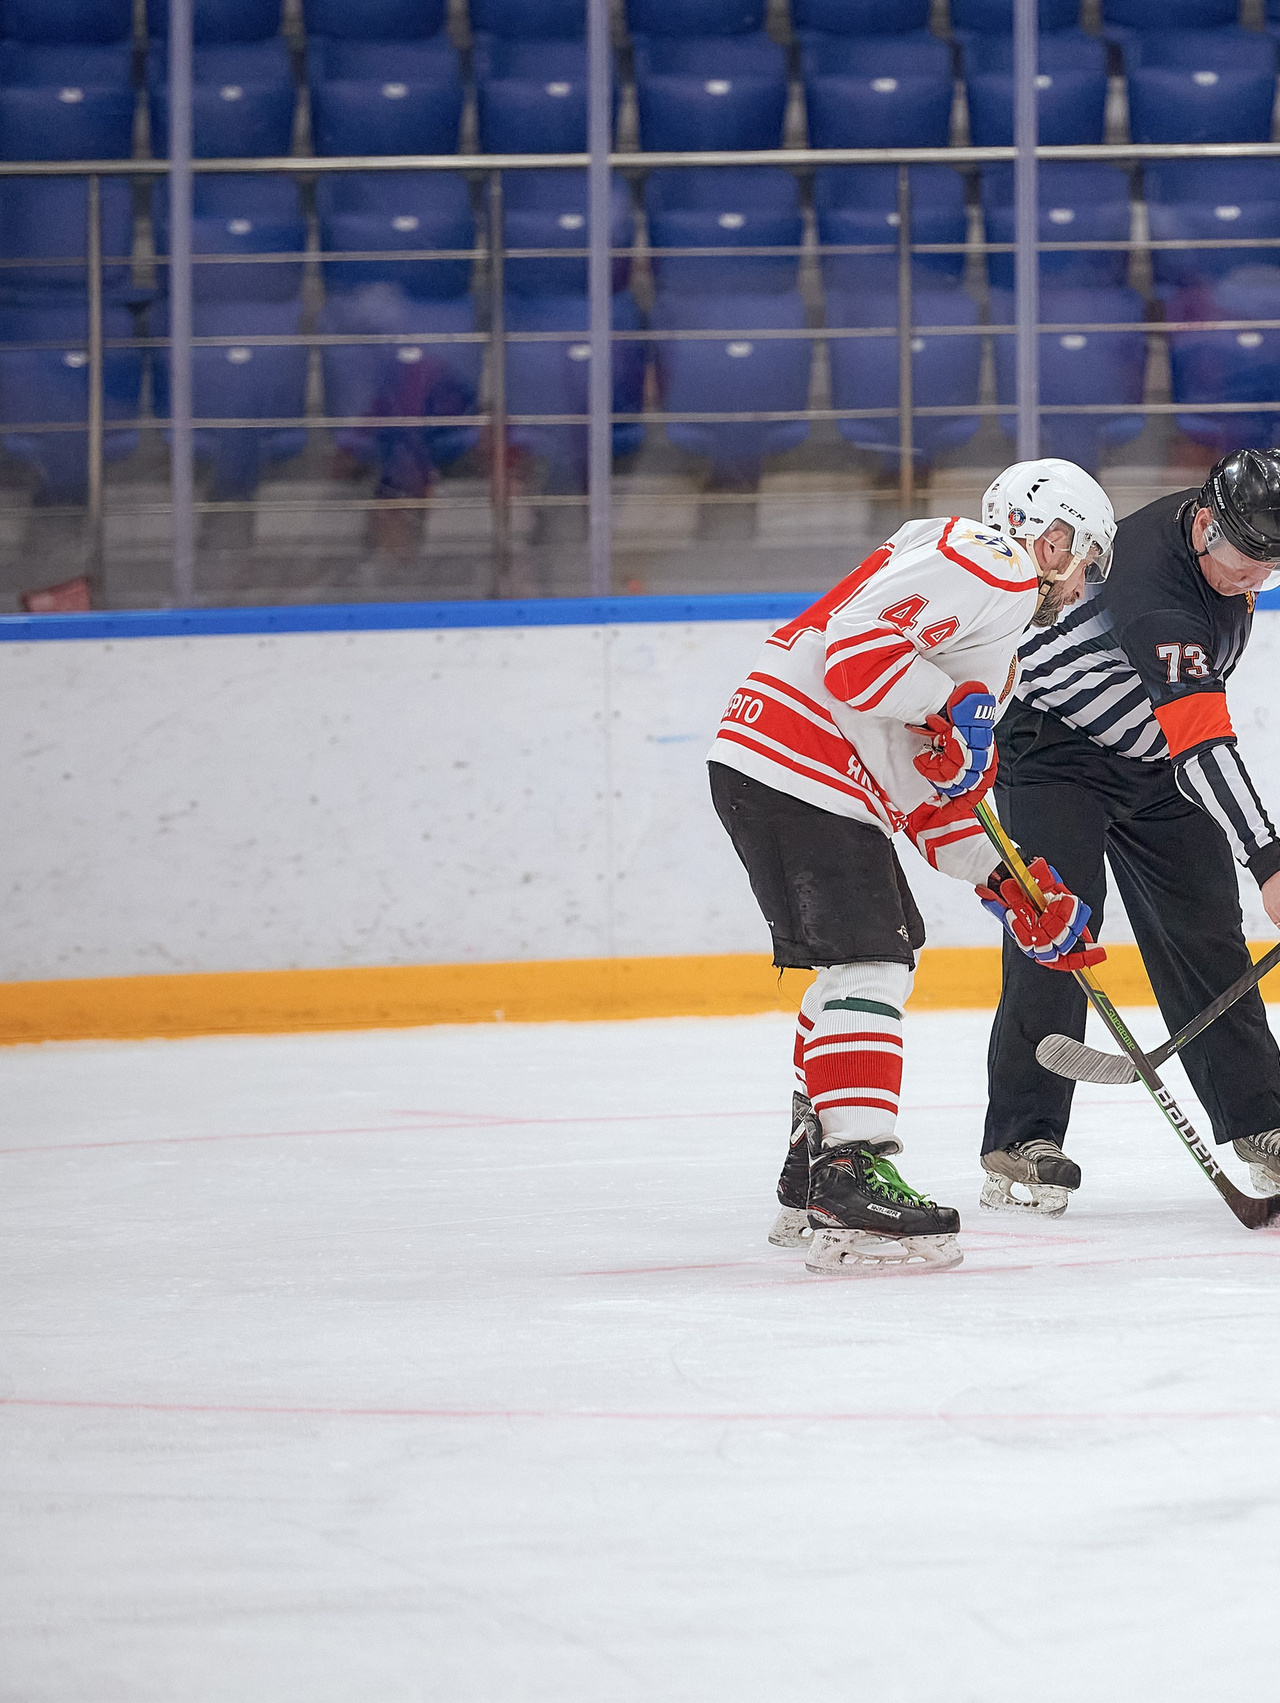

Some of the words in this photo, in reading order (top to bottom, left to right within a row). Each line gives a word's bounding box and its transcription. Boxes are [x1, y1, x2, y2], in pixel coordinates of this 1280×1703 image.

[1059, 502, 1086, 522] CCM
[877, 593, 961, 651] 44
[1155, 642, 1211, 684] 73
[1153, 1085, 1222, 1179] BAUER
